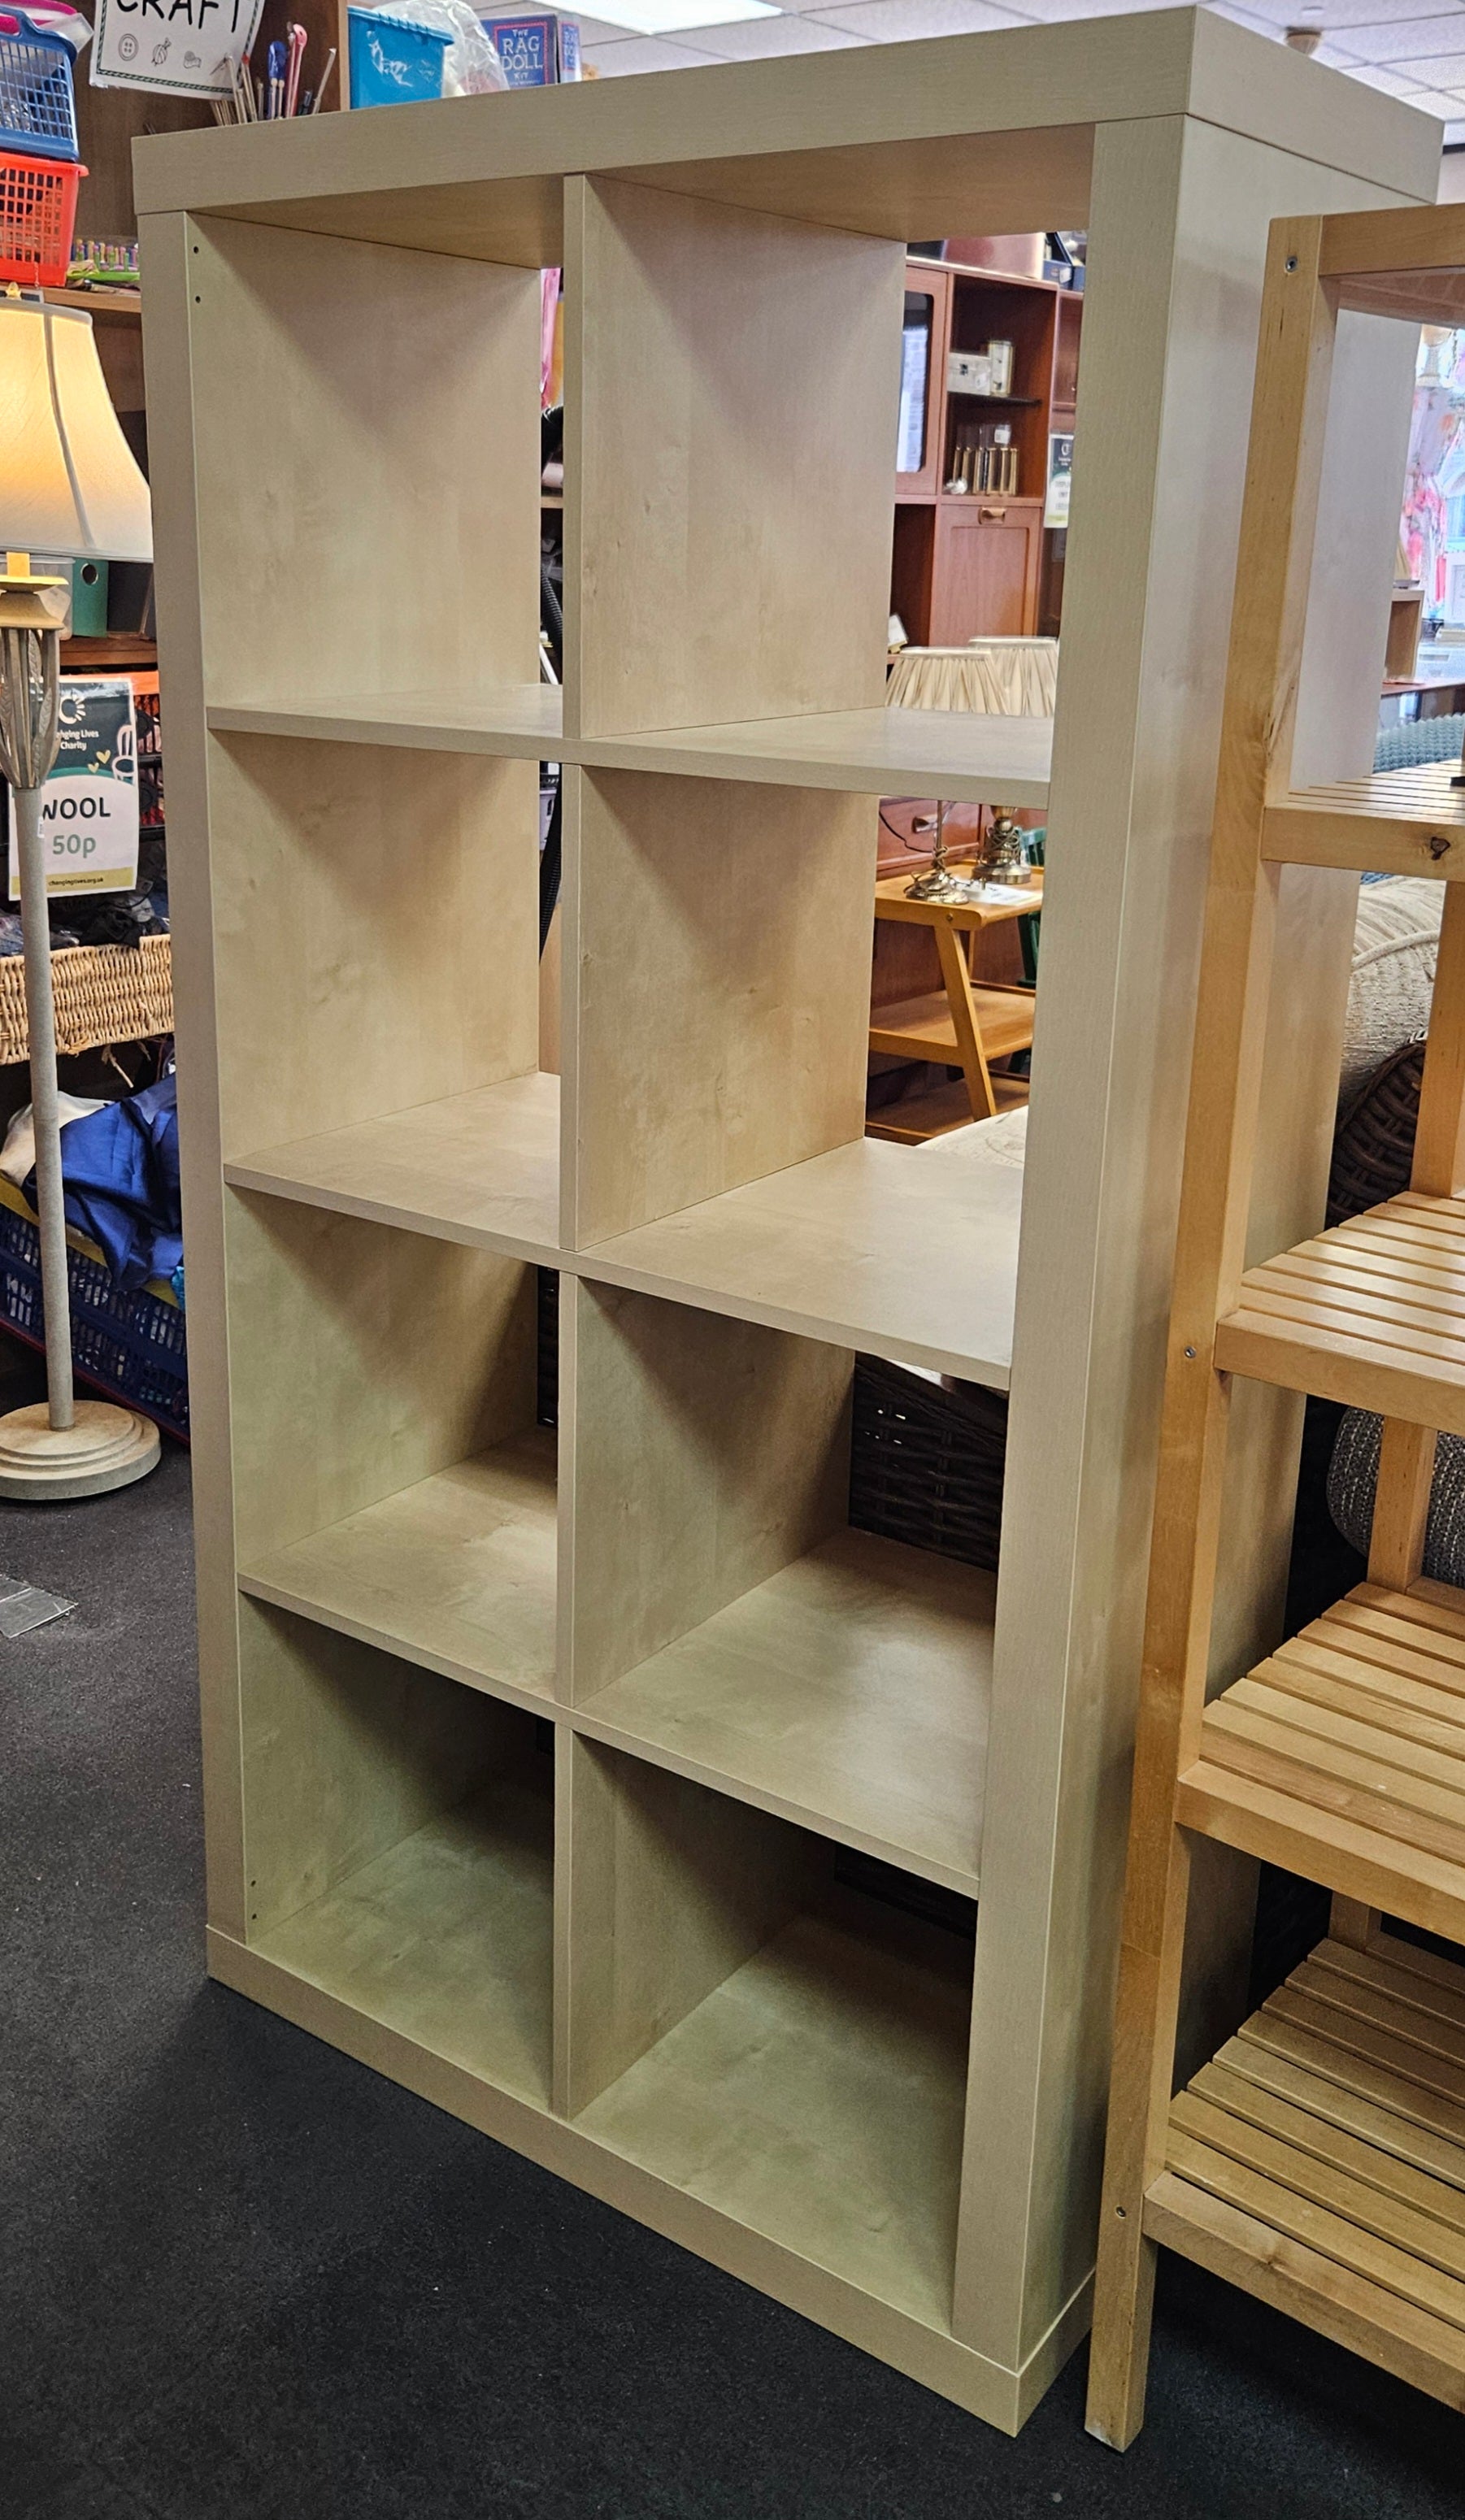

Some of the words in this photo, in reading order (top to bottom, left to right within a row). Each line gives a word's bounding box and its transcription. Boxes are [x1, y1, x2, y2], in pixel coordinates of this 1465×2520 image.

[117, 0, 239, 33] RAFT
[502, 36, 541, 54] RAG
[501, 54, 545, 71] DOLL
[81, 729, 99, 738] Lives
[60, 741, 87, 751] Charity
[42, 797, 111, 820] WOOL
[53, 834, 96, 858] 50p
